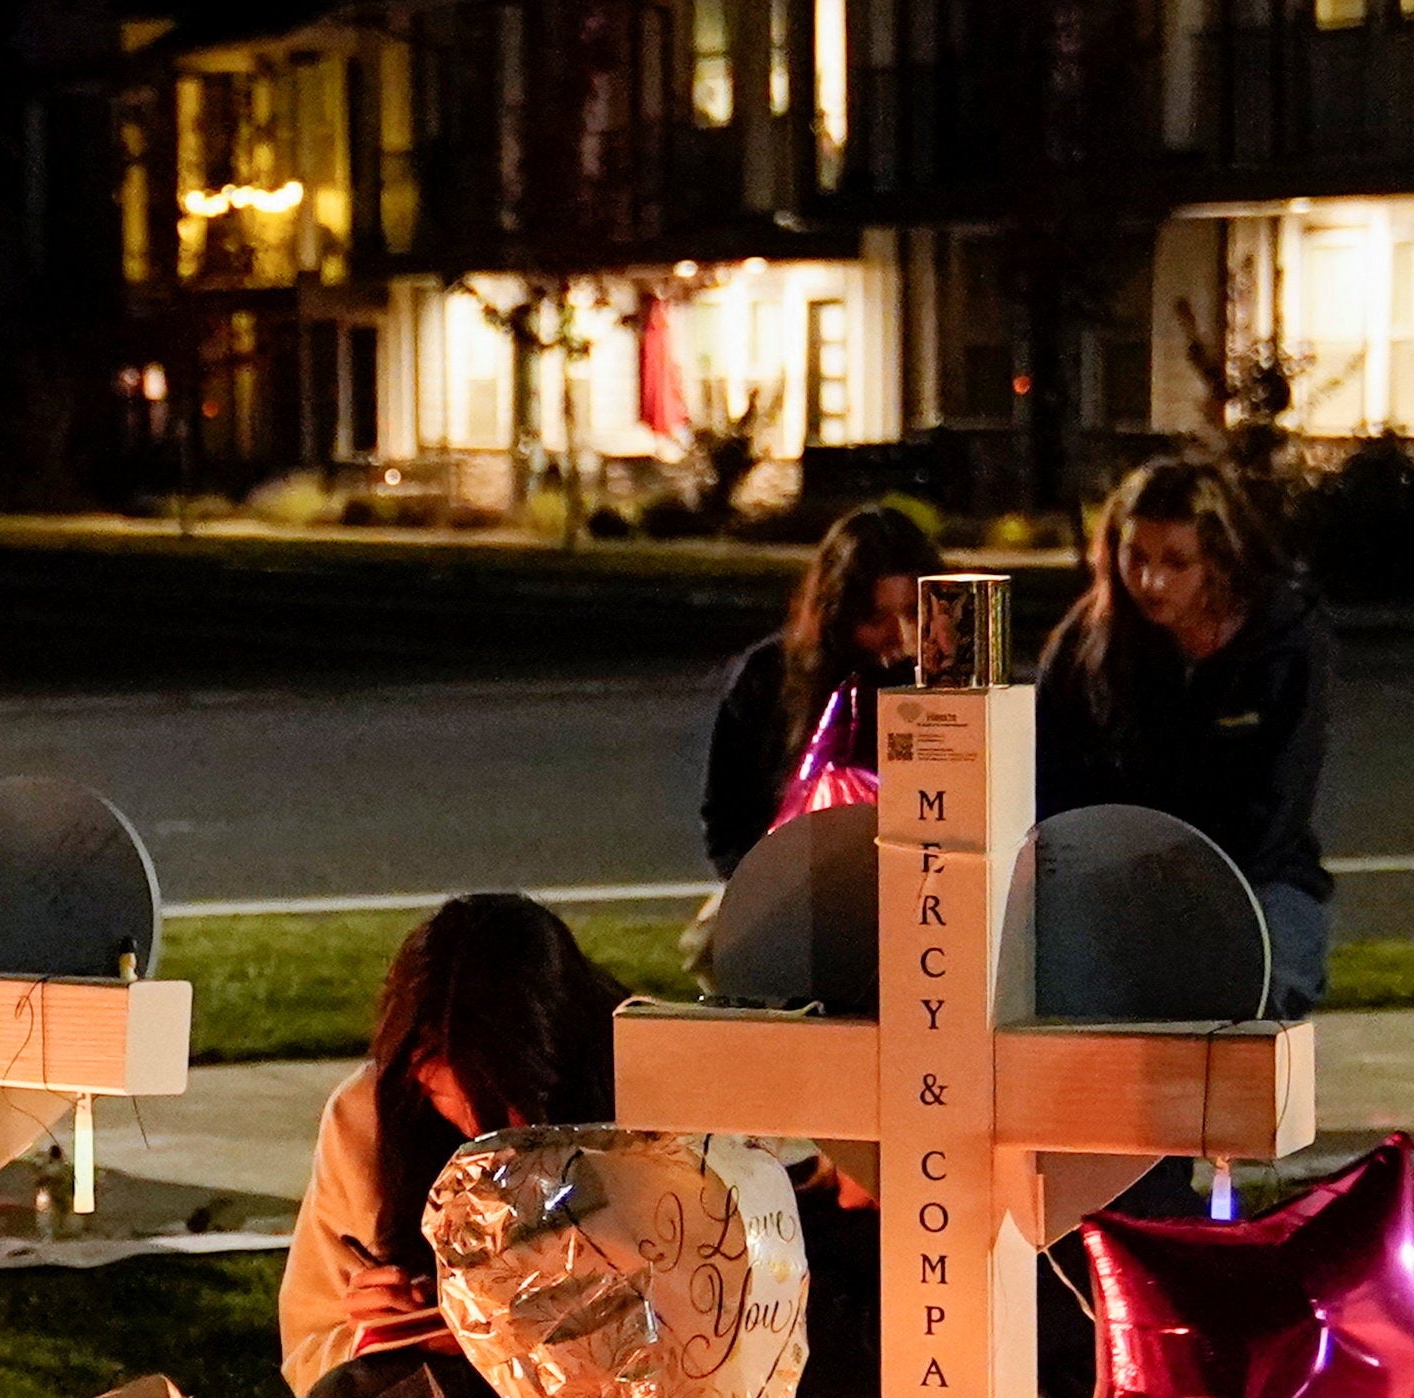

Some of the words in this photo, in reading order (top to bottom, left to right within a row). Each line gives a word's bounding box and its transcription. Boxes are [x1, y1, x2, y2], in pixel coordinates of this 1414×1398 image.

[918, 790, 947, 1030] MERCY
[919, 1073, 948, 1106] &
[681, 1260, 793, 1380] You
